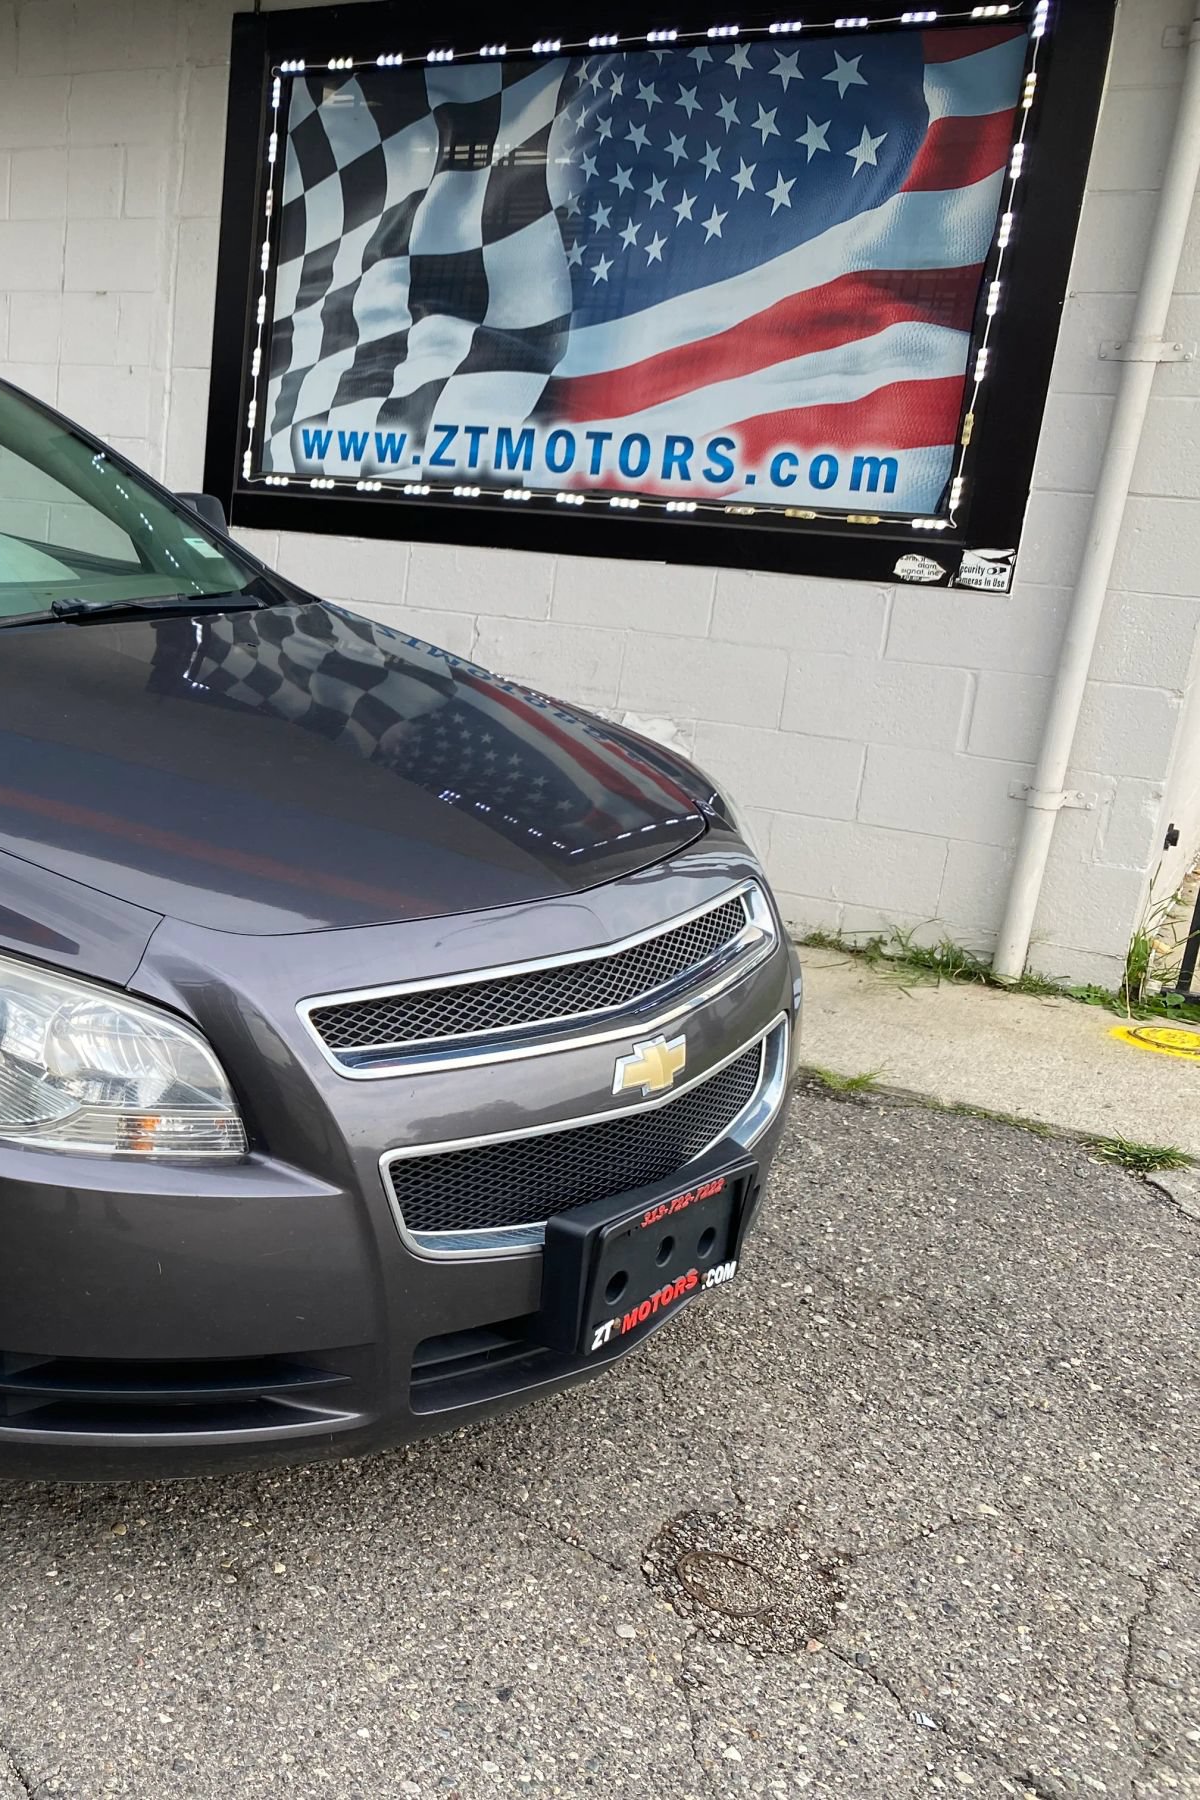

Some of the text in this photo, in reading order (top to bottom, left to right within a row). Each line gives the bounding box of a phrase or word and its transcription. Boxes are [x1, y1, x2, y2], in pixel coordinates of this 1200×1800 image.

[302, 424, 899, 494] www.ZTMOTORS.com
[960, 564, 986, 577] ecurity
[993, 578, 1005, 588] Use
[591, 1319, 615, 1351] ZT
